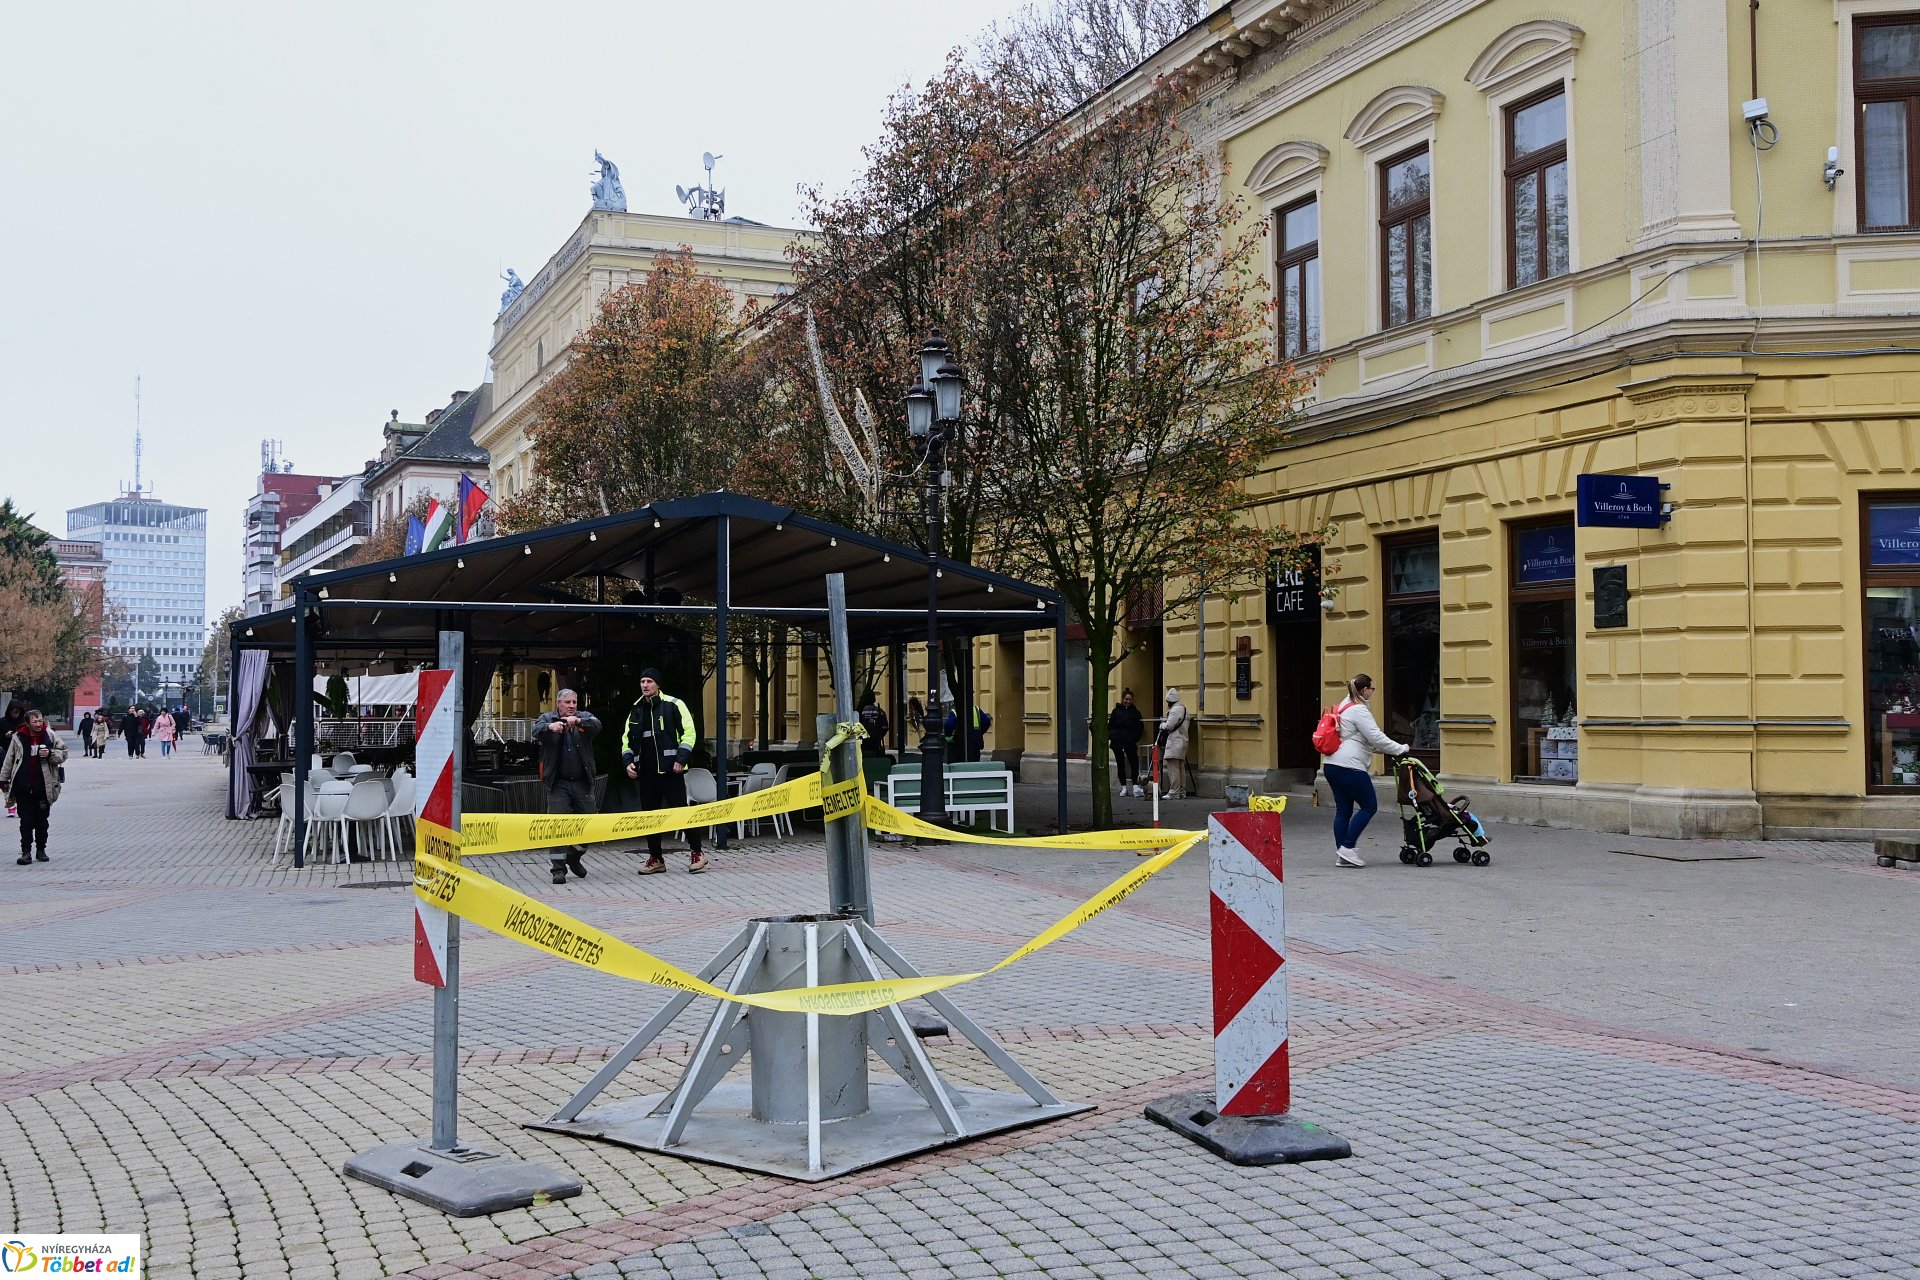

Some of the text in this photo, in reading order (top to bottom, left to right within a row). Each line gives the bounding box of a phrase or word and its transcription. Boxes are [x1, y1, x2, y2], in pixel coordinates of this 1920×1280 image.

[1594, 501, 1653, 513] Villeroy & Boch
[1879, 538, 1920, 549] Villero
[1526, 557, 1552, 567] Villeroy
[1276, 590, 1305, 612] CAFE
[503, 902, 604, 965] VÁROSÜZEMELTETÉS
